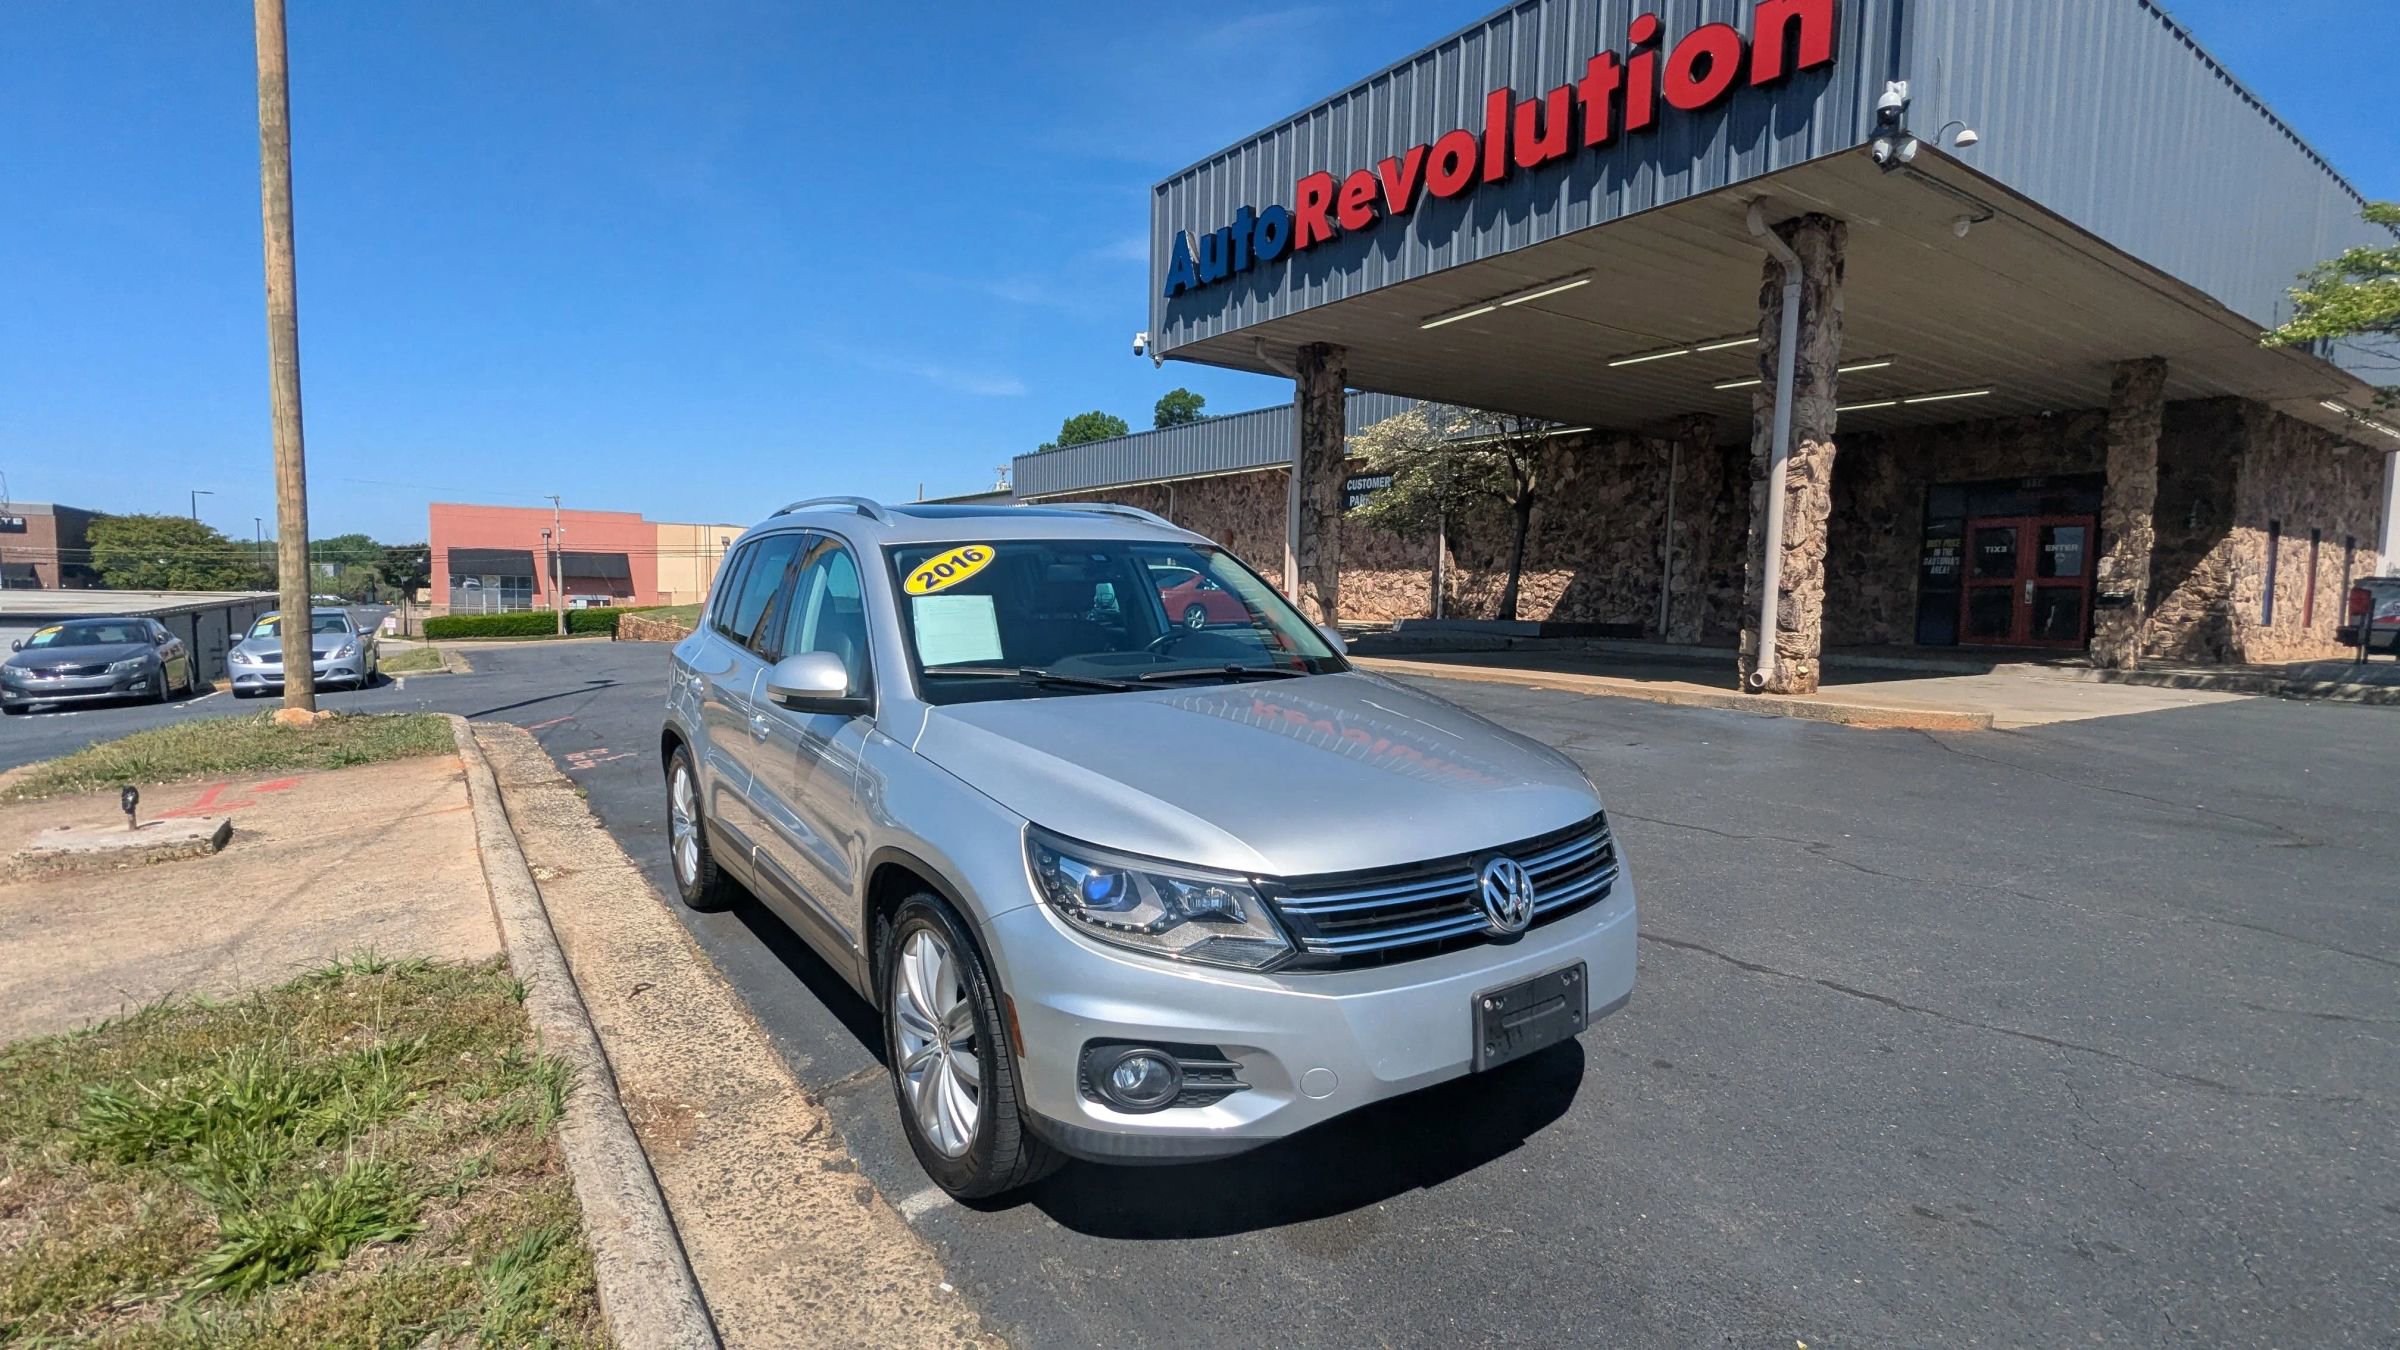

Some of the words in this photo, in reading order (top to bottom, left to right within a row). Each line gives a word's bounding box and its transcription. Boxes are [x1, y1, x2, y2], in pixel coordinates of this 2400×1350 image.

[1346, 476, 1391, 491] CUSTOMER
[0, 517, 23, 525] TE
[2045, 544, 2078, 552] ENTER
[916, 548, 984, 590] 2016
